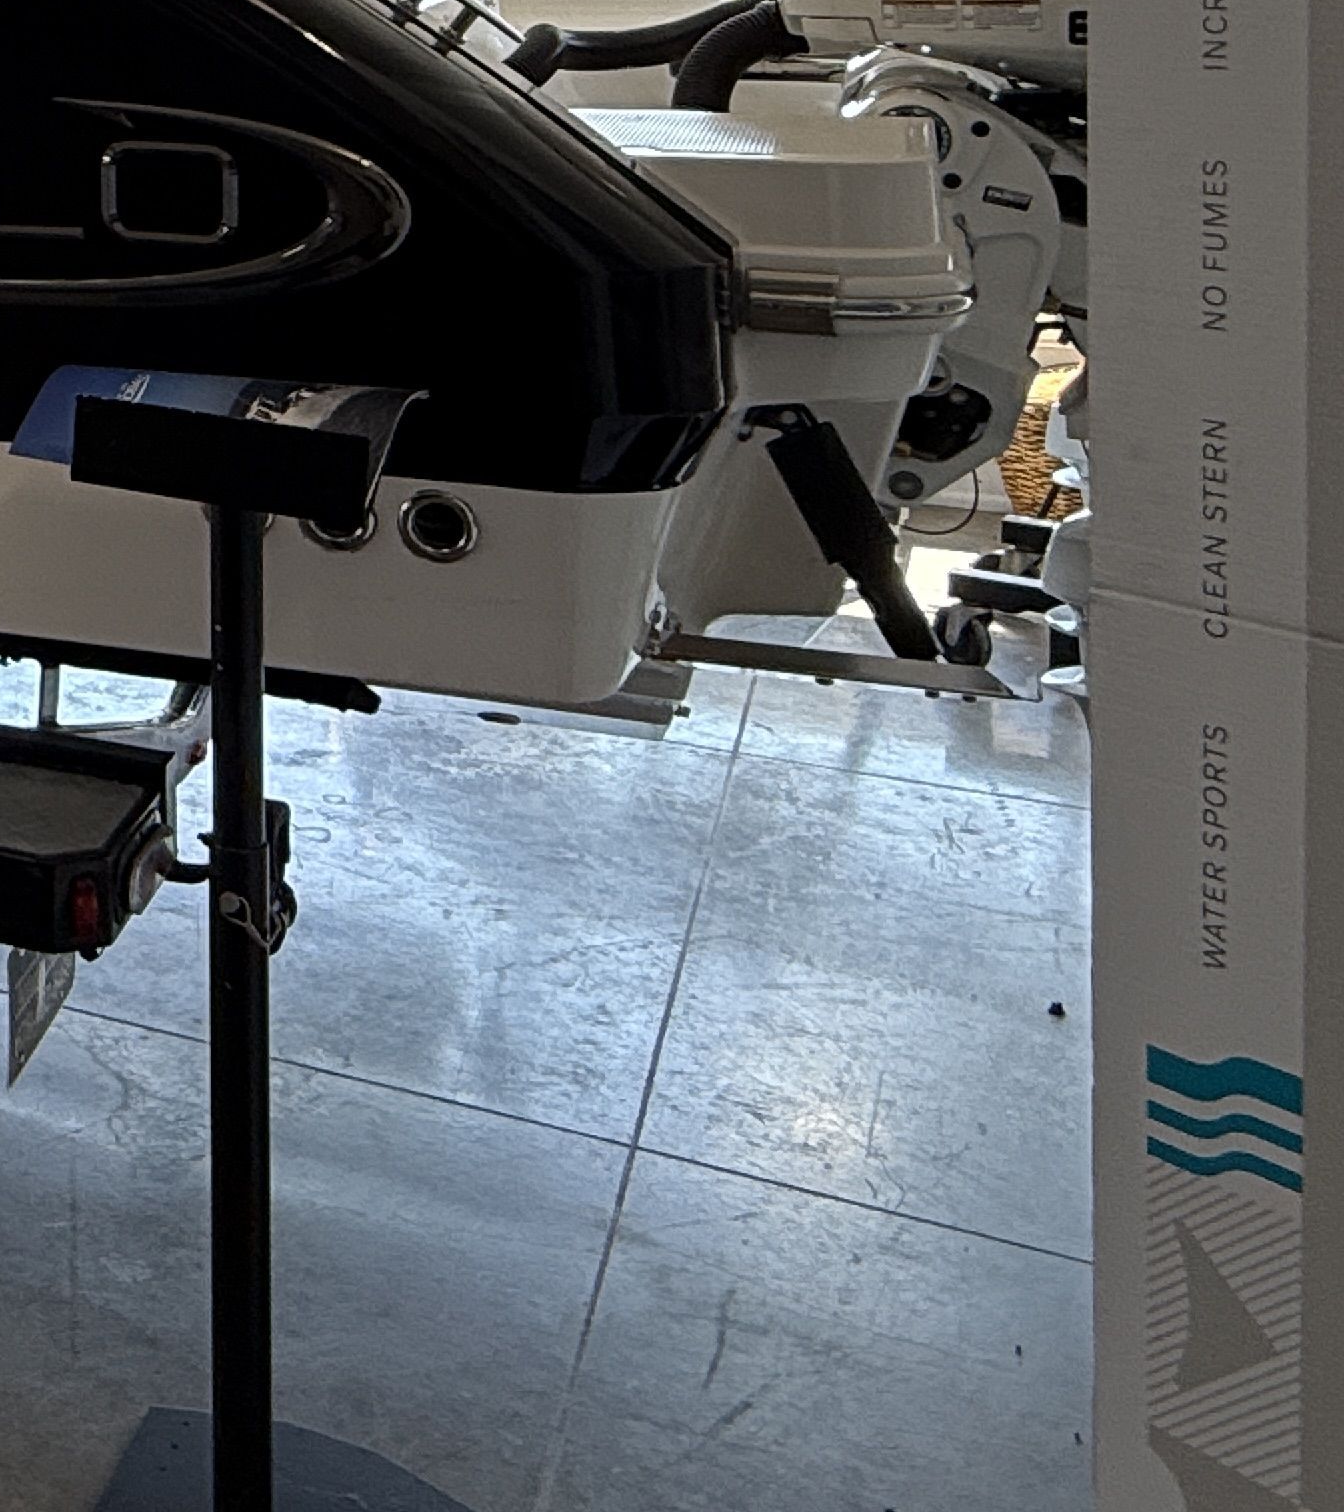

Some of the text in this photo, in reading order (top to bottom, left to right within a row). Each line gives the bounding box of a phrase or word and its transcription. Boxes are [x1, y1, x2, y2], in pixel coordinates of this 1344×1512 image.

[1201, 159, 1230, 333] NO FUMES
[1201, 418, 1231, 640] CLEAN STERN
[1201, 723, 1230, 970] WATER SPORTS
